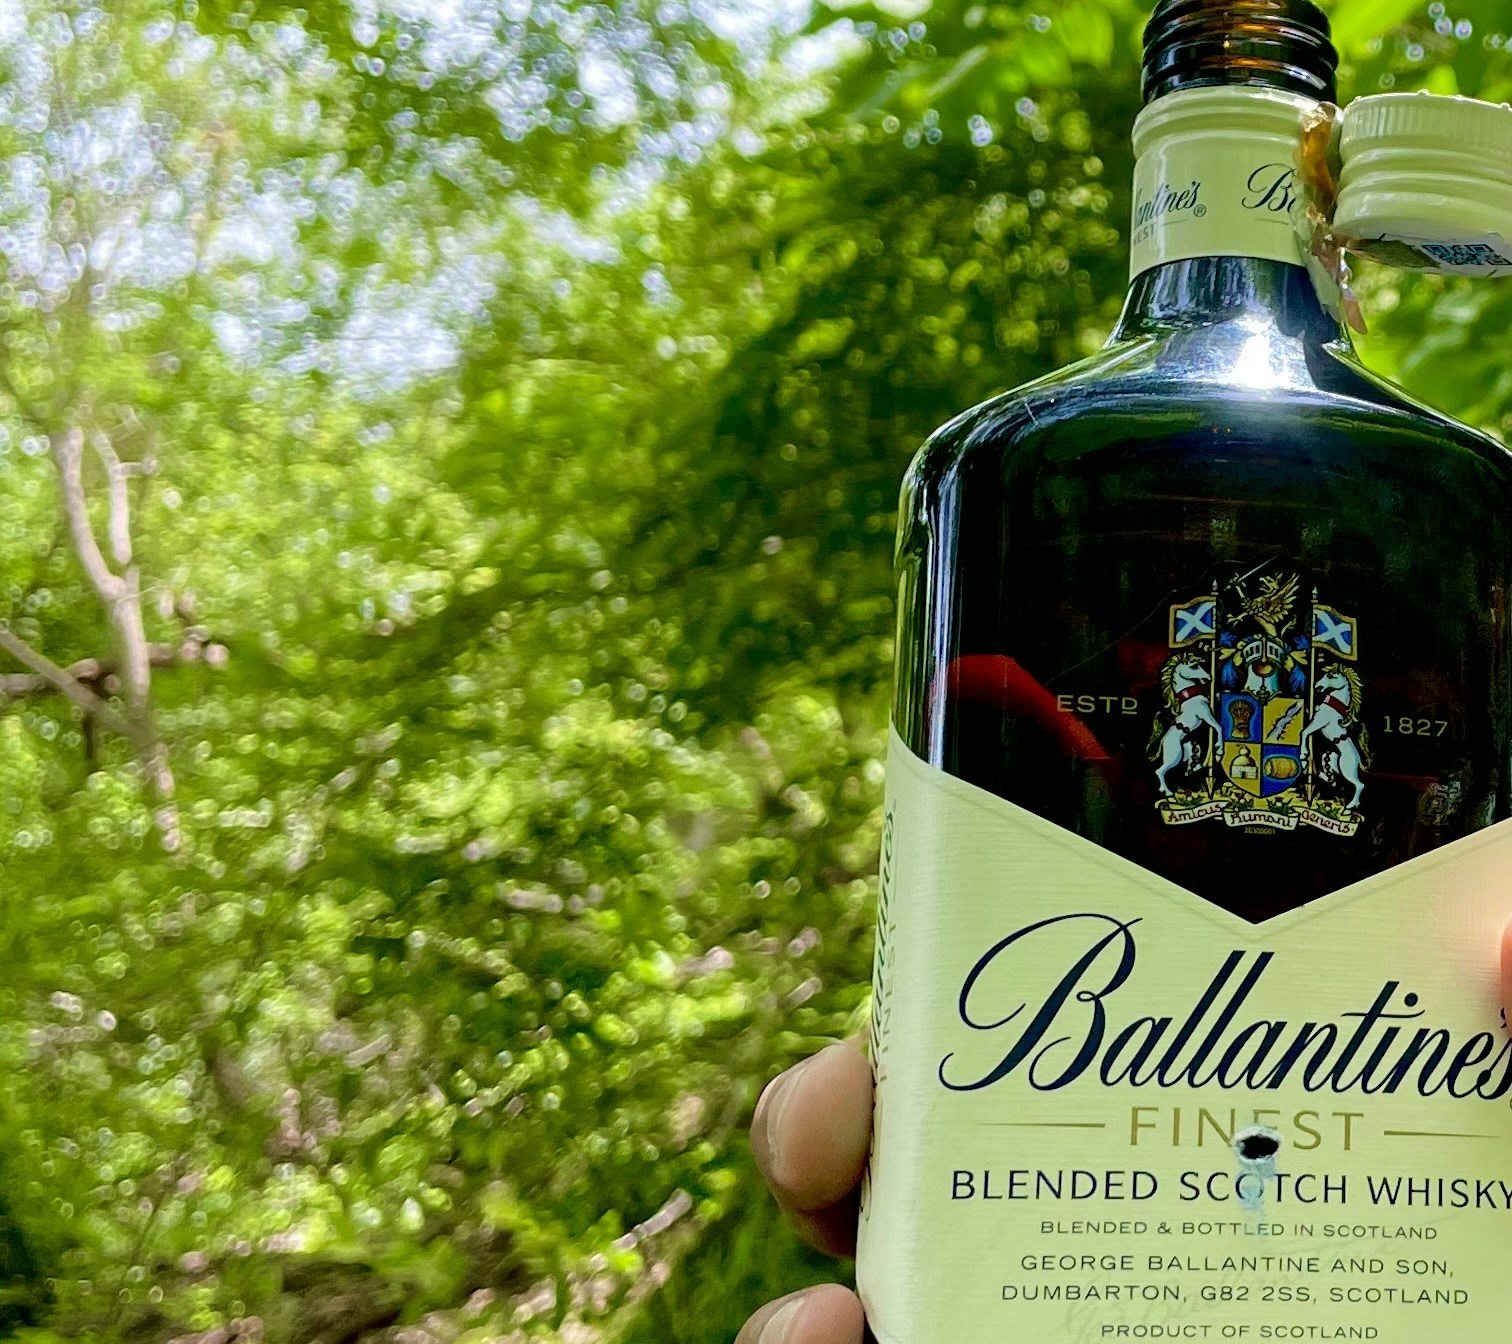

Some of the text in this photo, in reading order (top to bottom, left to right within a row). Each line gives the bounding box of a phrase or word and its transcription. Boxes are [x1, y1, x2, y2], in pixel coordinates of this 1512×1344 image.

[1056, 694, 1139, 716] ESTD
[1383, 715, 1449, 738] 1827
[951, 1169, 1158, 1201] BLENDED
[1179, 1170, 1347, 1205] SCOTCH
[1040, 1221, 1438, 1241] BLENDED & BOTTLED IN SCOTLAND
[1020, 1254, 1454, 1278] GEORGE BALLANTINE AND SON,
[1001, 1284, 1469, 1306] DUMBARTON, G82 2SS, SCOTLAND
[1101, 1324, 1379, 1340] PRODUCT OF SCOTLAND
